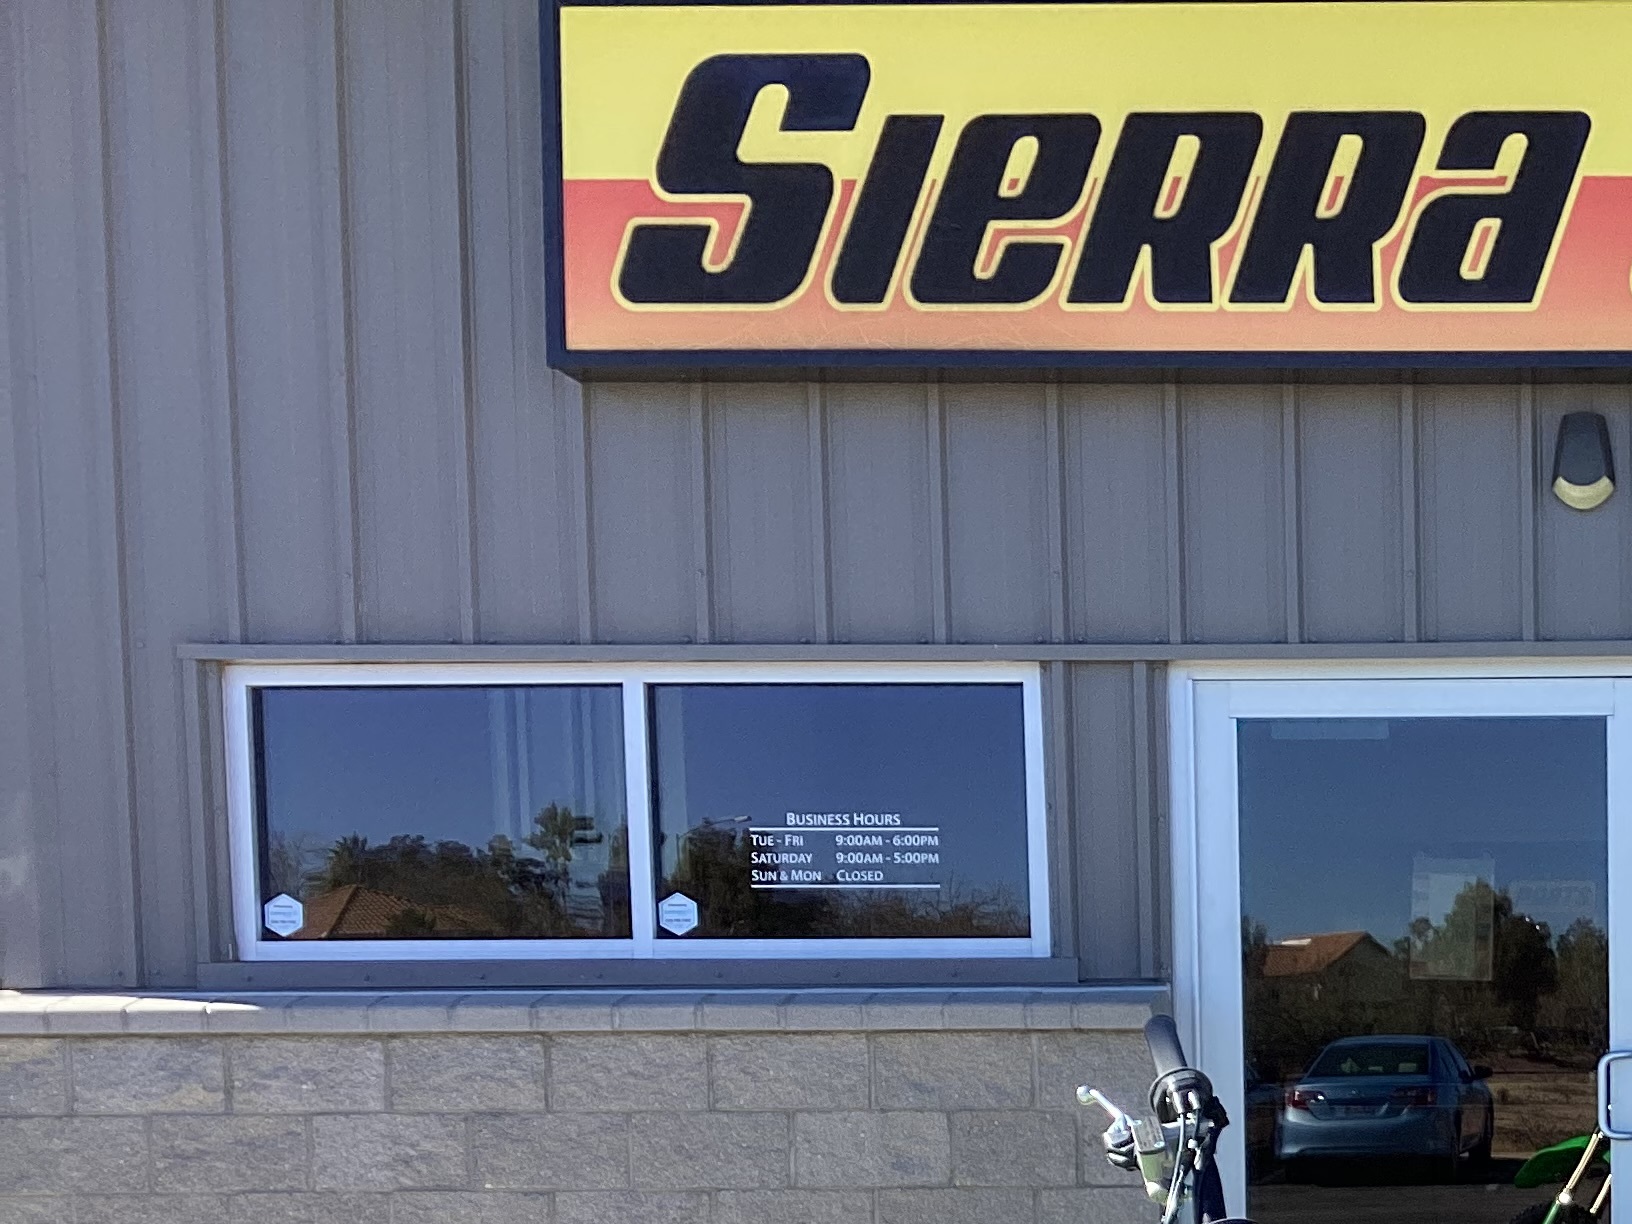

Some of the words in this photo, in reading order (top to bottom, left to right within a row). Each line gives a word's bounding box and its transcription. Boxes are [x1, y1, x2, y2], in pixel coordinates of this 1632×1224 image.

[835, 834, 883, 847] 9:00AM
[892, 834, 939, 847] 6:00PM
[751, 852, 813, 865] SATURDAY
[835, 852, 884, 864] 9:00AM
[893, 852, 940, 864] 5:00PM
[779, 870, 789, 882] &
[836, 869, 884, 882] CLOSED
